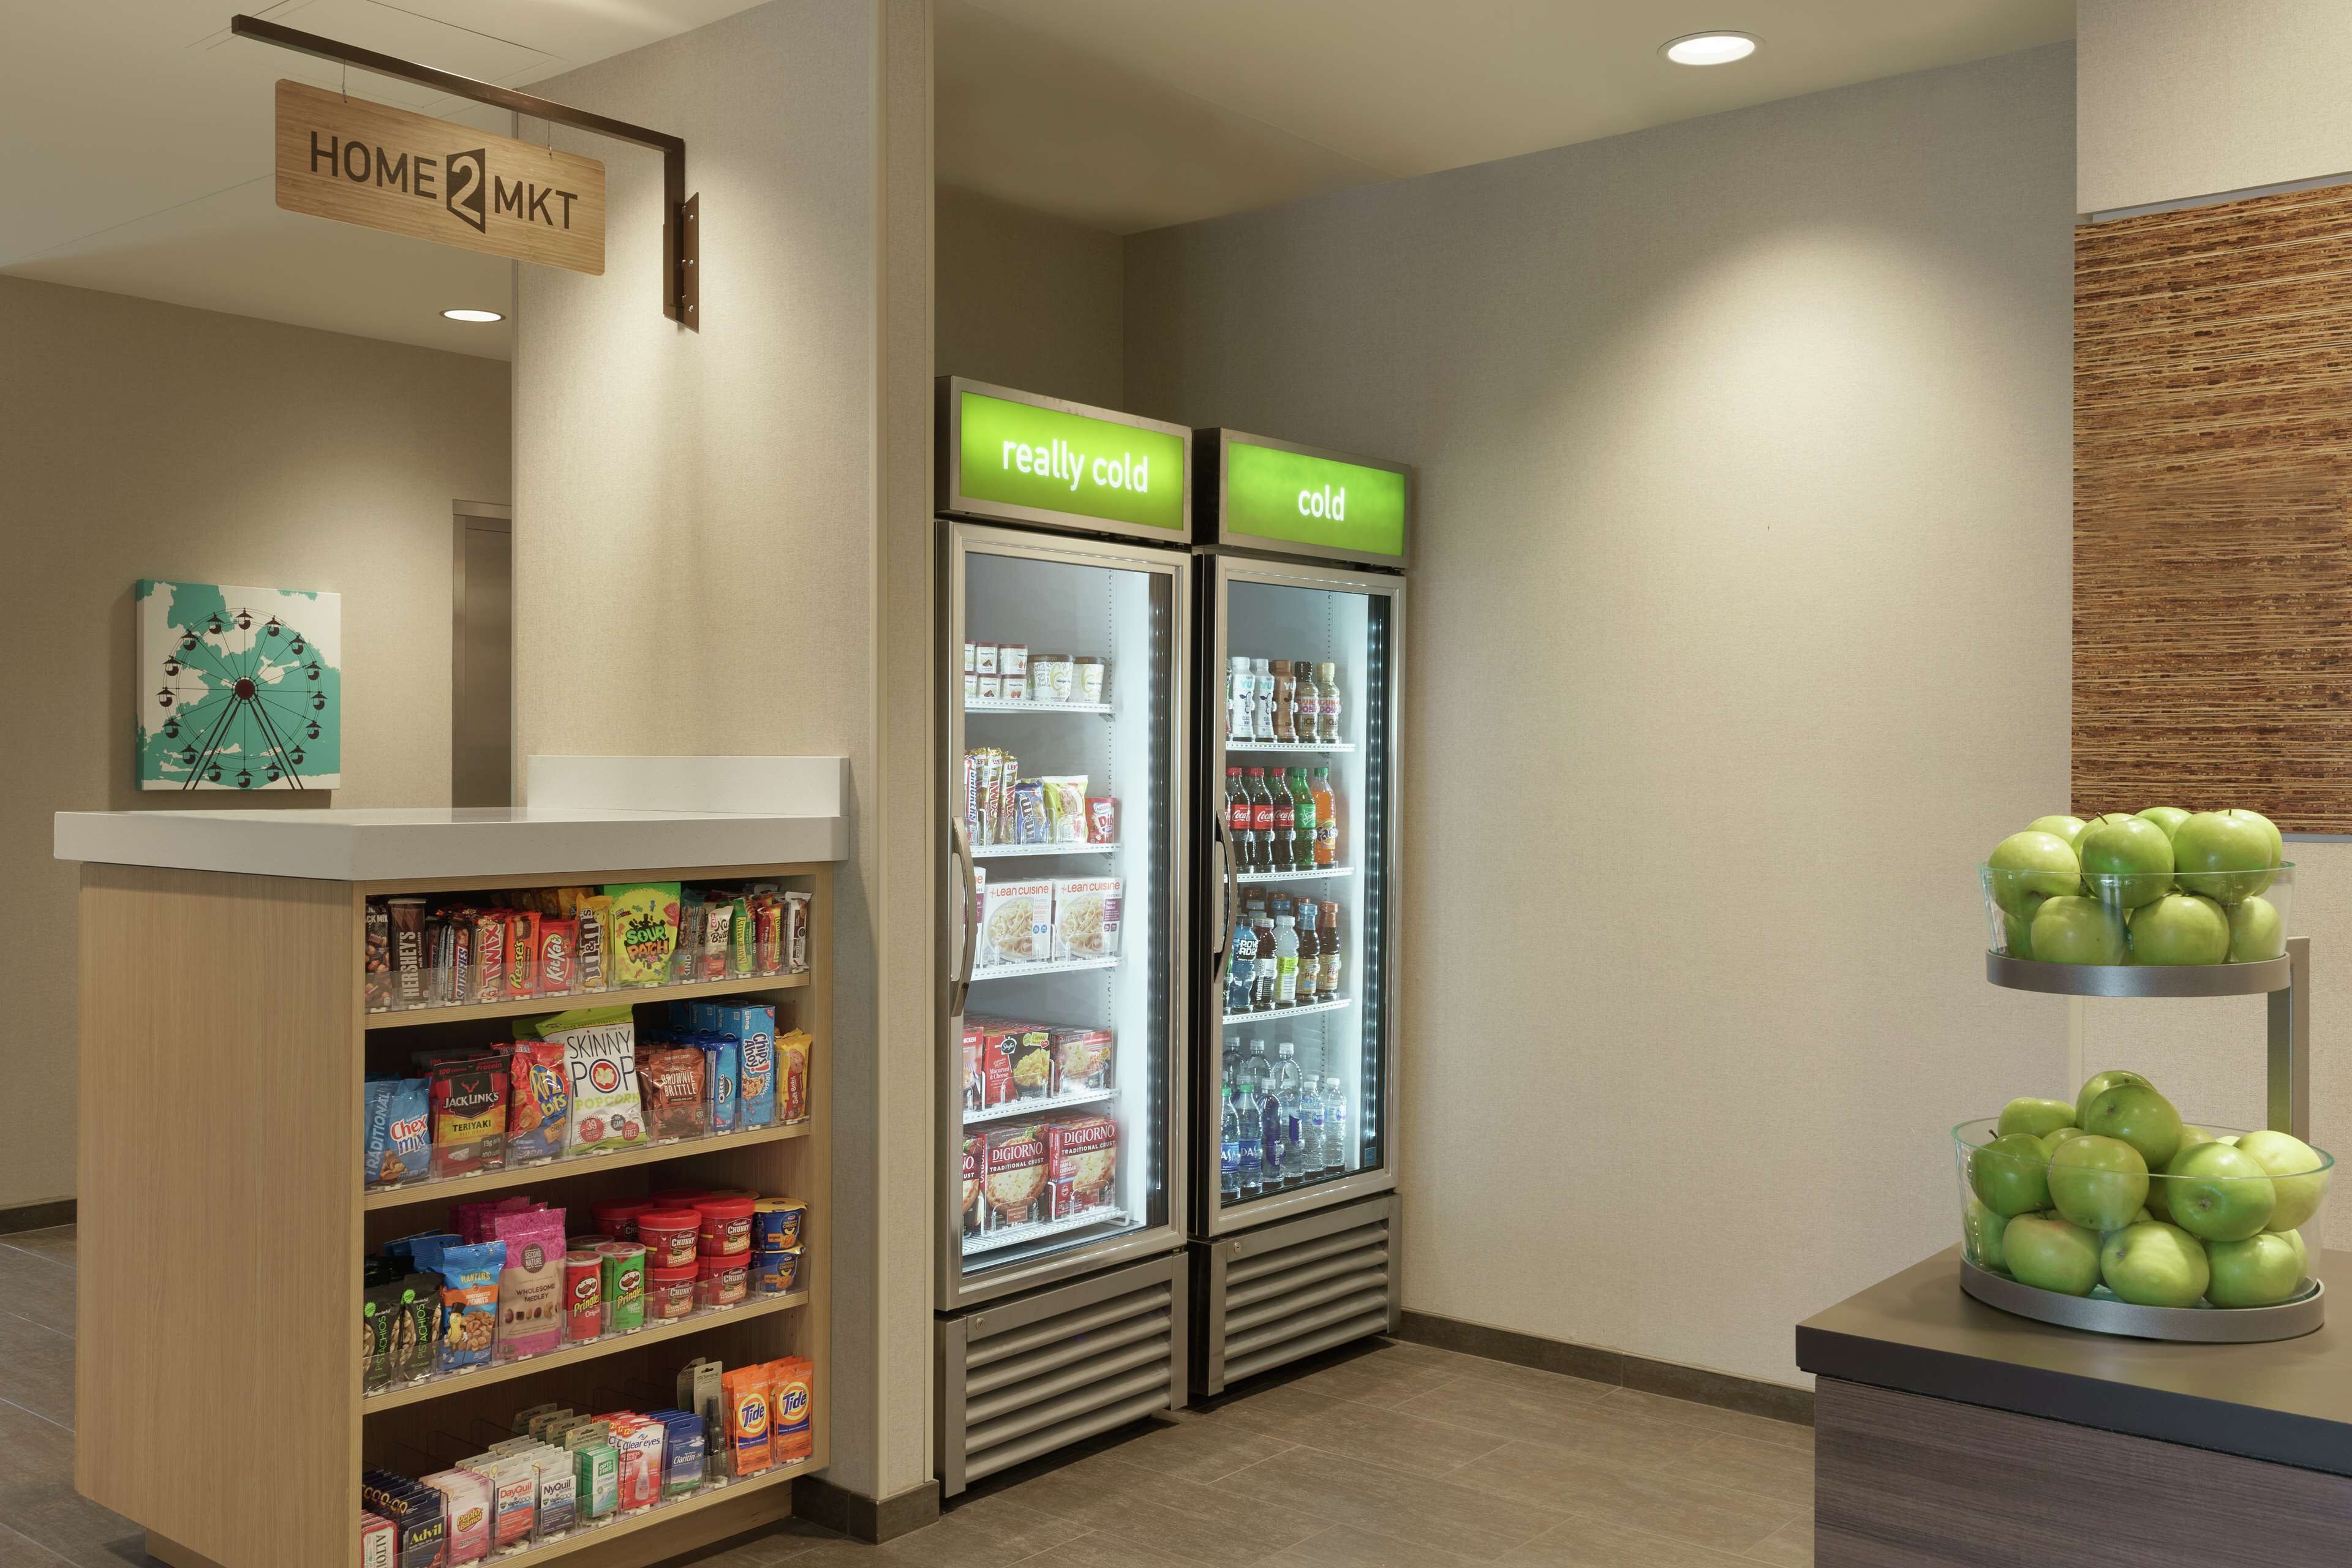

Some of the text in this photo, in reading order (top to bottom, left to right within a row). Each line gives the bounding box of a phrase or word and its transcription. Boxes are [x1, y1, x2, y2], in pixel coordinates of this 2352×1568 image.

[1003, 438, 1148, 492] really cold
[1297, 485, 1345, 521] cold
[625, 925, 667, 945] SOUR
[625, 940, 669, 962] PATCH
[737, 940, 747, 963] NATURE
[399, 931, 420, 997] HERSHEY'S
[509, 940, 524, 989] Reese's
[567, 1030, 631, 1059] SKINNY
[752, 1032, 769, 1066] Chips
[475, 1061, 502, 1071] Protein
[989, 1066, 1009, 1074] Macaroni
[570, 1055, 635, 1098] POP
[661, 1071, 696, 1085] BROWNIE
[664, 1082, 698, 1097] BRITTLE
[443, 1091, 499, 1109] JACK LINK'S
[575, 1092, 639, 1111] POPCORN
[390, 1114, 428, 1141] Chex
[452, 1119, 491, 1133] TERIYAKI
[586, 1119, 597, 1131] 39
[613, 1120, 624, 1128] GMO
[624, 1128, 638, 1138] FREE
[366, 1092, 391, 1175] TRADITIONAL
[398, 1129, 428, 1156] mix
[1064, 1123, 1116, 1145] DIGIORNO
[992, 1141, 1044, 1163] DIGIORNO
[1061, 1144, 1098, 1155] TRADITIONAL
[990, 1161, 1027, 1172] TRADITIONAL
[728, 1224, 750, 1234] CHUNKY
[671, 1236, 695, 1247] CHUNKY
[524, 1248, 541, 1260] SECOND
[524, 1258, 542, 1268] NATURE
[723, 1273, 745, 1283] CHUNKY
[515, 1283, 556, 1295] WHOLESOME
[524, 1292, 549, 1303] MEDLEY
[616, 1286, 643, 1310] Pringles
[669, 1287, 692, 1297] CHUNKY
[573, 1294, 600, 1317] Pringles
[417, 1303, 428, 1359] PISTACHIOS
[375, 1315, 388, 1371] PISTACHIOS
[782, 1389, 807, 1416] Tide
[741, 1400, 765, 1428] Tide
[622, 1438, 660, 1450] Clear eyes
[673, 1453, 695, 1464] Claritin
[599, 1464, 613, 1476] FREE
[500, 1482, 532, 1499] DayQuil
[543, 1479, 571, 1495] NyQuil
[457, 1509, 483, 1525] Pepto-
[460, 1512, 482, 1530] Bismol
[410, 1523, 442, 1545] Advil
